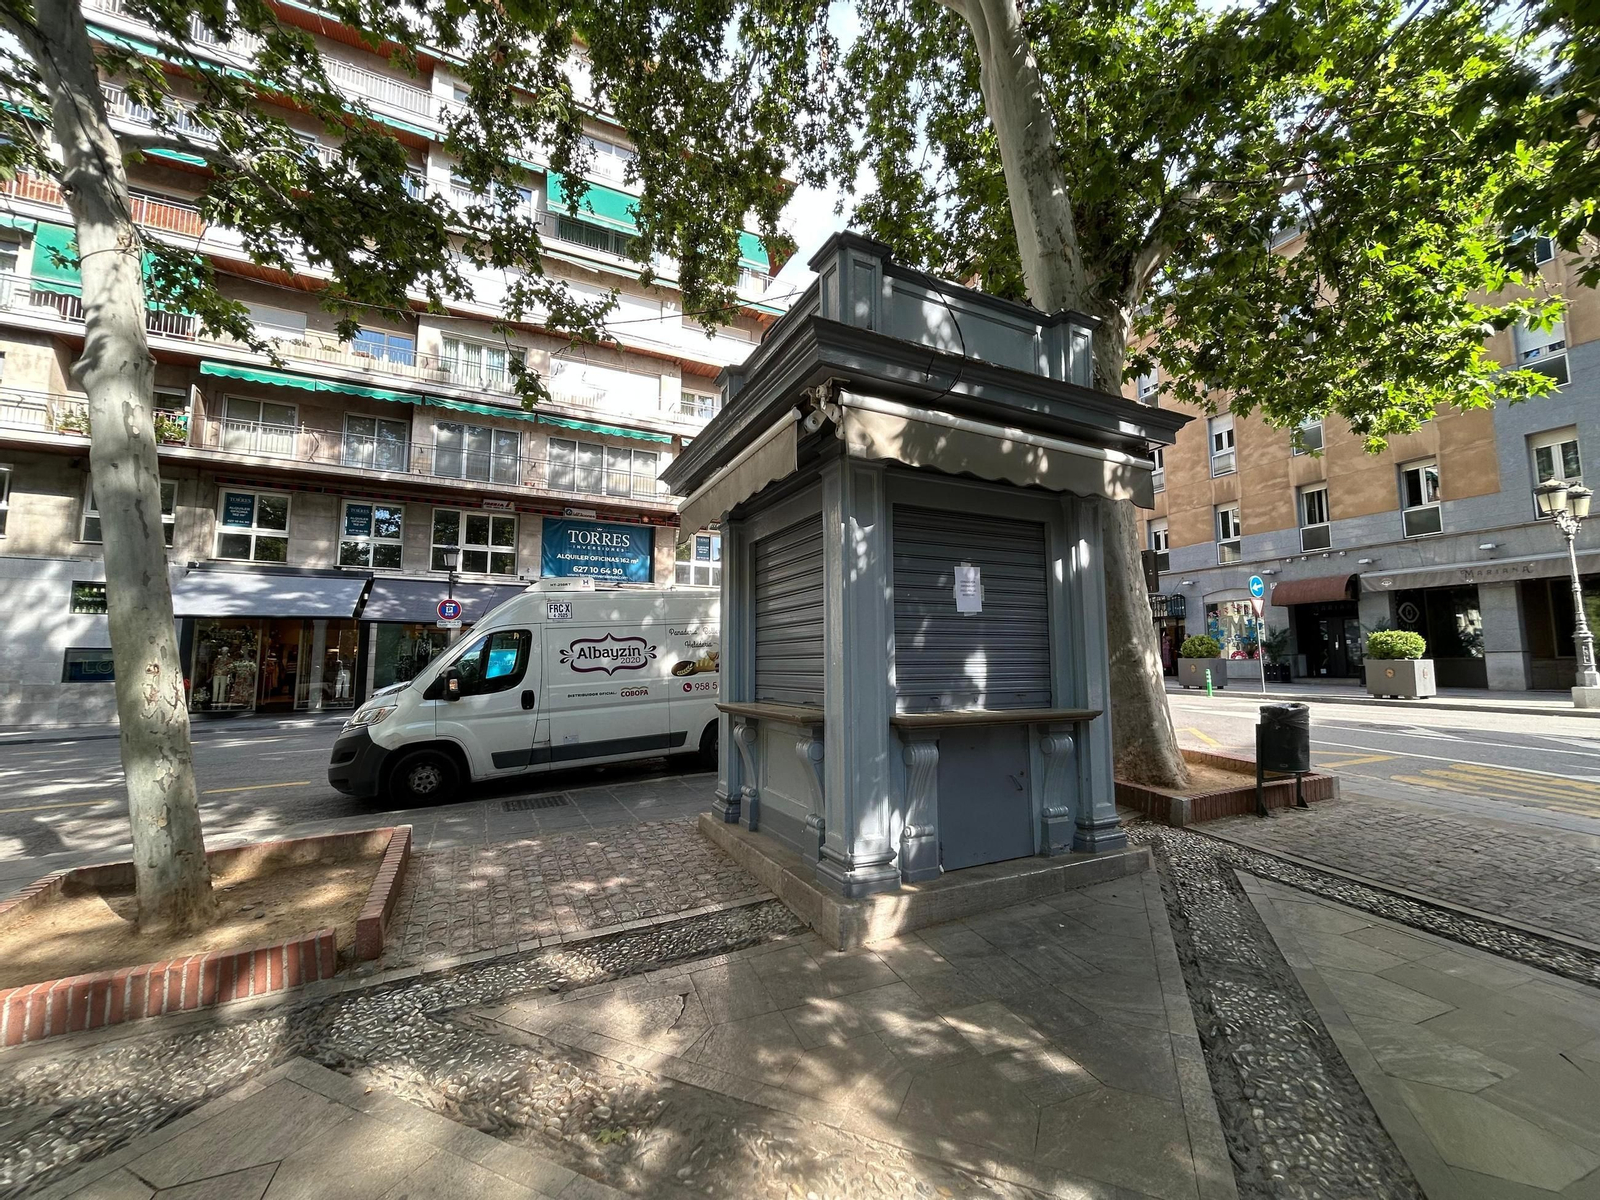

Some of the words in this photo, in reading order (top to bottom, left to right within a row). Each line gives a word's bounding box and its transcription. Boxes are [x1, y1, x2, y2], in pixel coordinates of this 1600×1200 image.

[568, 530, 630, 547] TORRES
[1460, 566, 1534, 578] MARIANA
[577, 645, 641, 660] Albayzín
